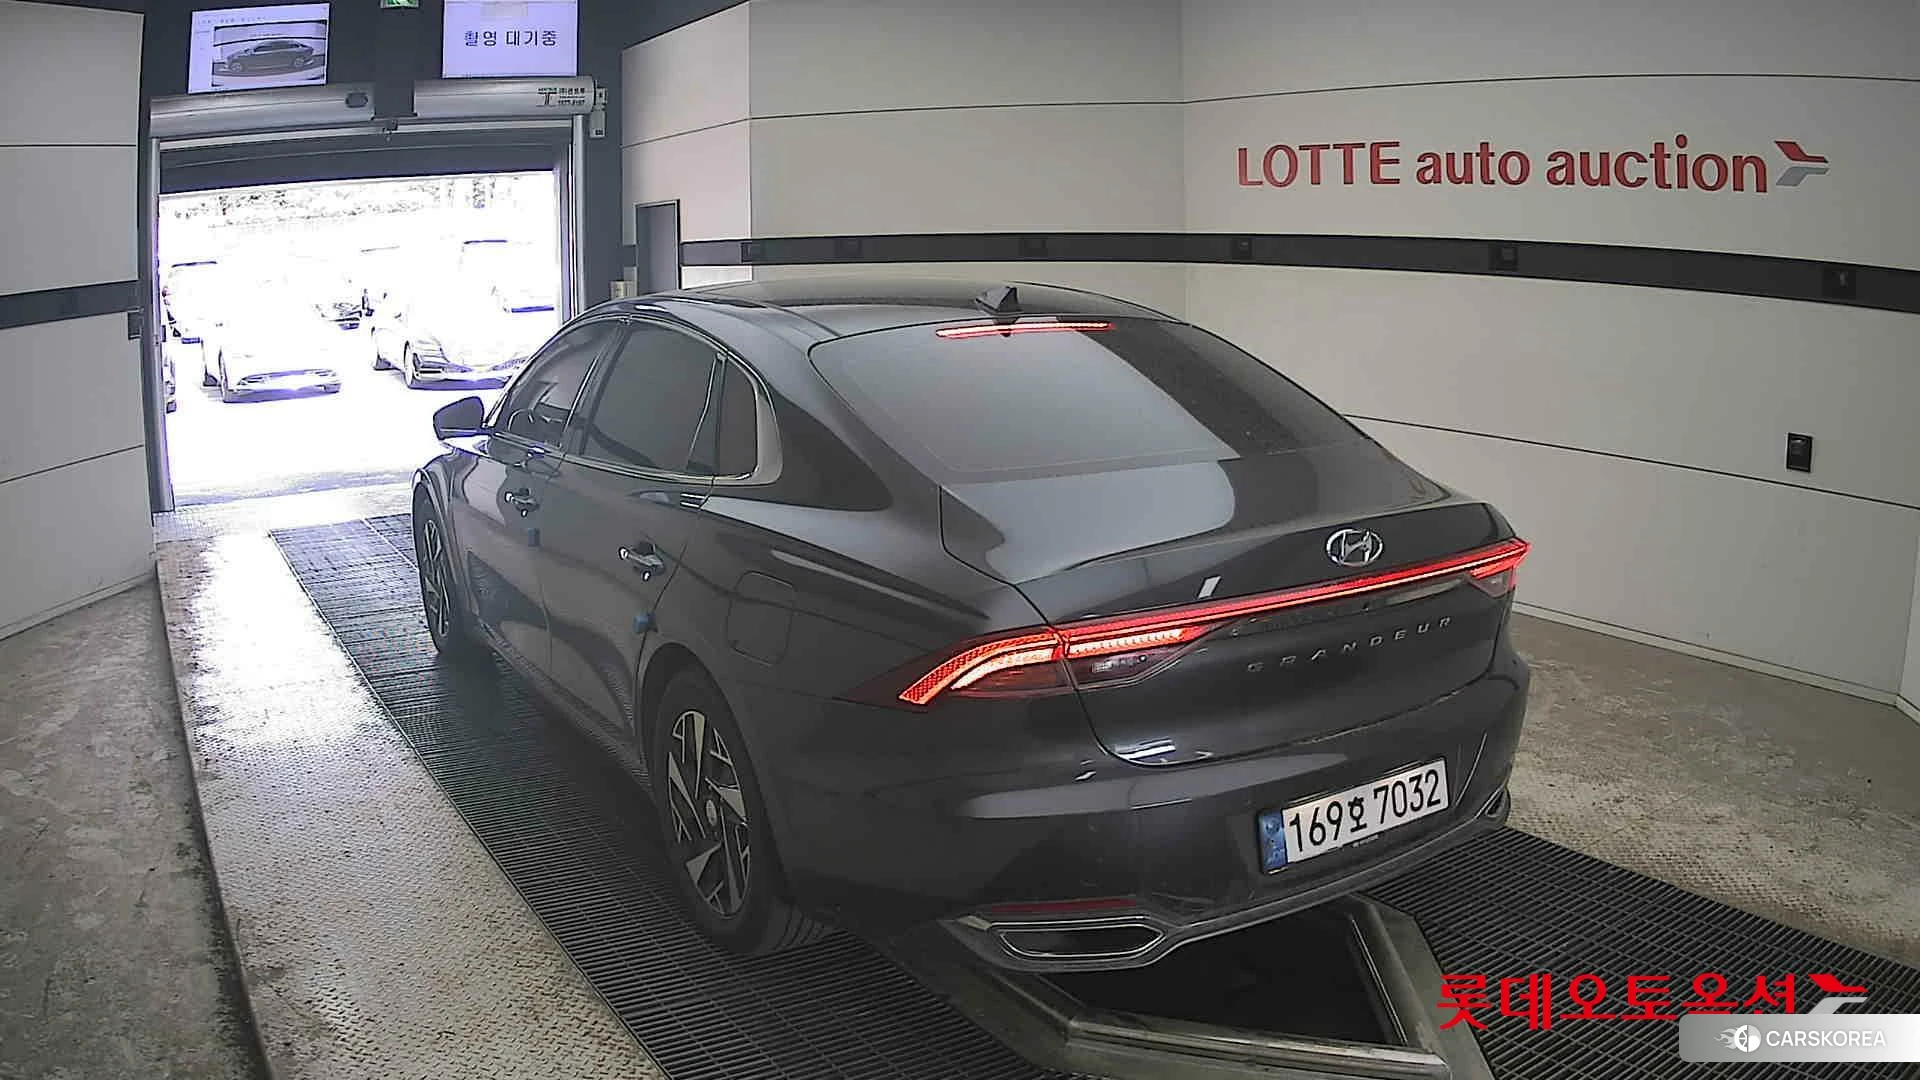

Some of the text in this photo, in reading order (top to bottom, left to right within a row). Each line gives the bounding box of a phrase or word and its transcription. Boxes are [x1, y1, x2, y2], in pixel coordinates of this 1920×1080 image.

[506, 30, 558, 47] 대기중
[1236, 134, 1768, 193] LOTTE auto auction
[1246, 615, 1452, 673] GRANDEUR
[1288, 768, 1442, 853] 169호 7032
